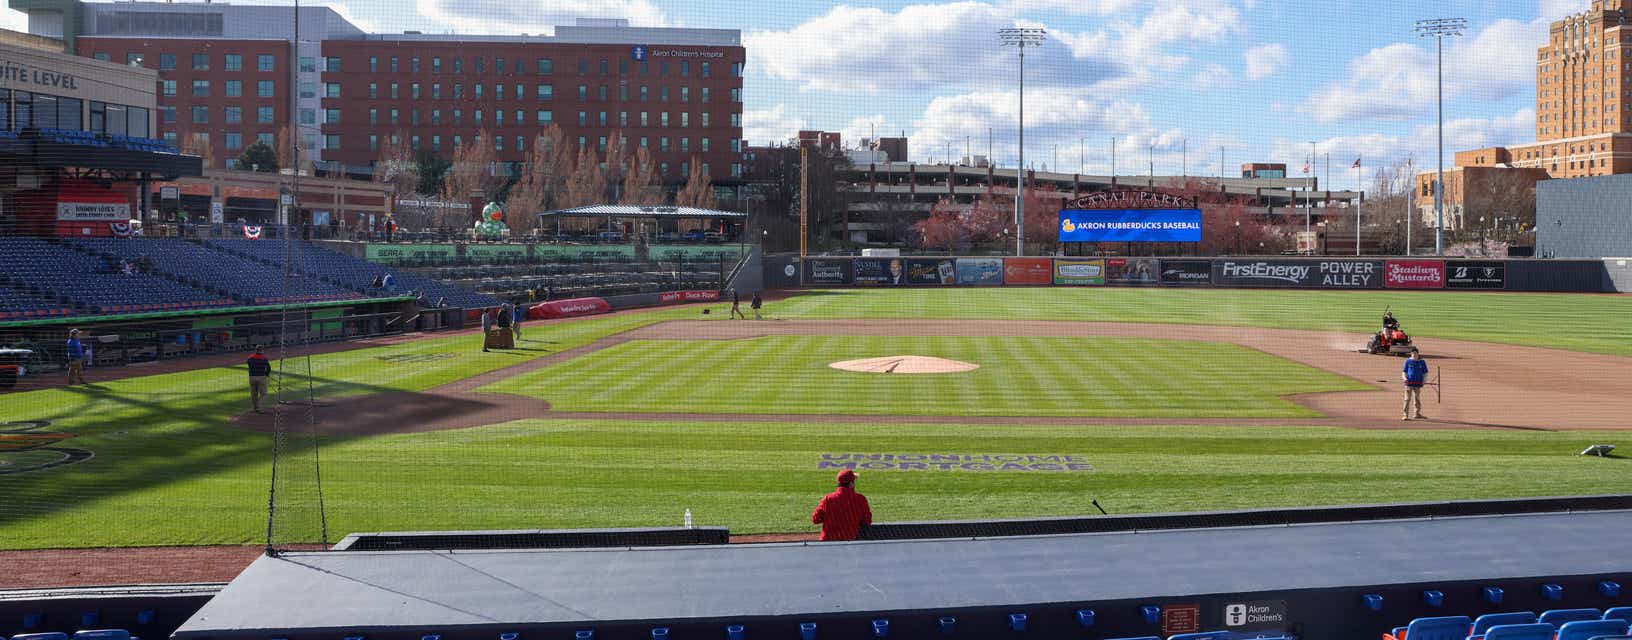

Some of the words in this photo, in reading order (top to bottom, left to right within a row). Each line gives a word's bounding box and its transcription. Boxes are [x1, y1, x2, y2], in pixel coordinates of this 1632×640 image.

[33, 70, 77, 89] LEVEL
[1077, 191, 1130, 208] CANAL
[1140, 192, 1182, 206] PARK
[1077, 222, 1106, 230] AKRON
[1107, 222, 1162, 230] RUBBERDUCKS
[1163, 222, 1200, 230] BASEBALL
[1223, 262, 1310, 279] FirstEnergy
[1320, 262, 1374, 273] POWER
[1390, 264, 1439, 275] Stadium
[812, 271, 843, 279] Authority
[1322, 275, 1371, 286] ALLEY
[818, 461, 1094, 471] MORTGAGE
[1248, 605, 1270, 614] Akron
[1247, 613, 1283, 623] Children's
